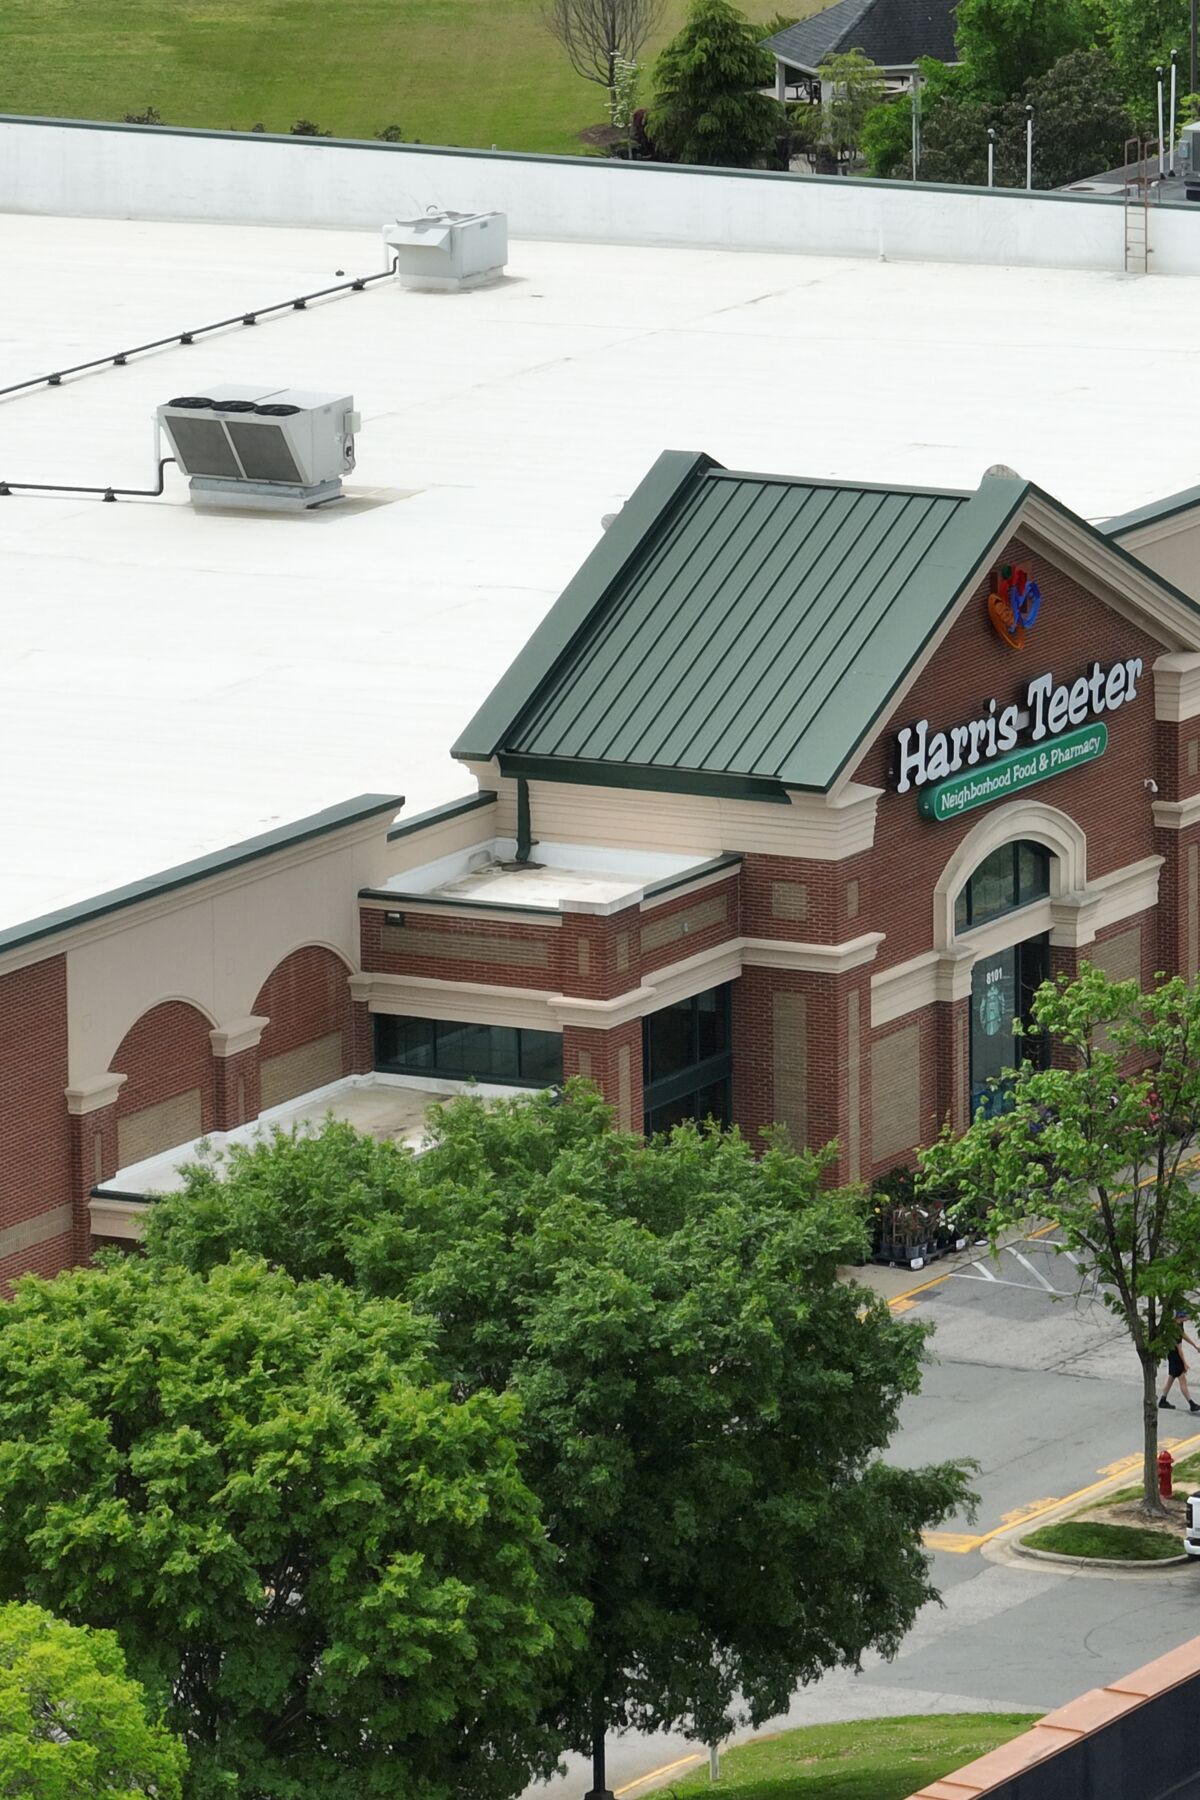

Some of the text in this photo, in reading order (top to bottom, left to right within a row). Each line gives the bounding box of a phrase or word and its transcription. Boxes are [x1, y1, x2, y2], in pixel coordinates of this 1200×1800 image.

[897, 657, 1144, 793] Harris Teeter
[941, 735, 1101, 811] Neighborhood Food & Pharmacy
[986, 967, 1003, 985] 8101
